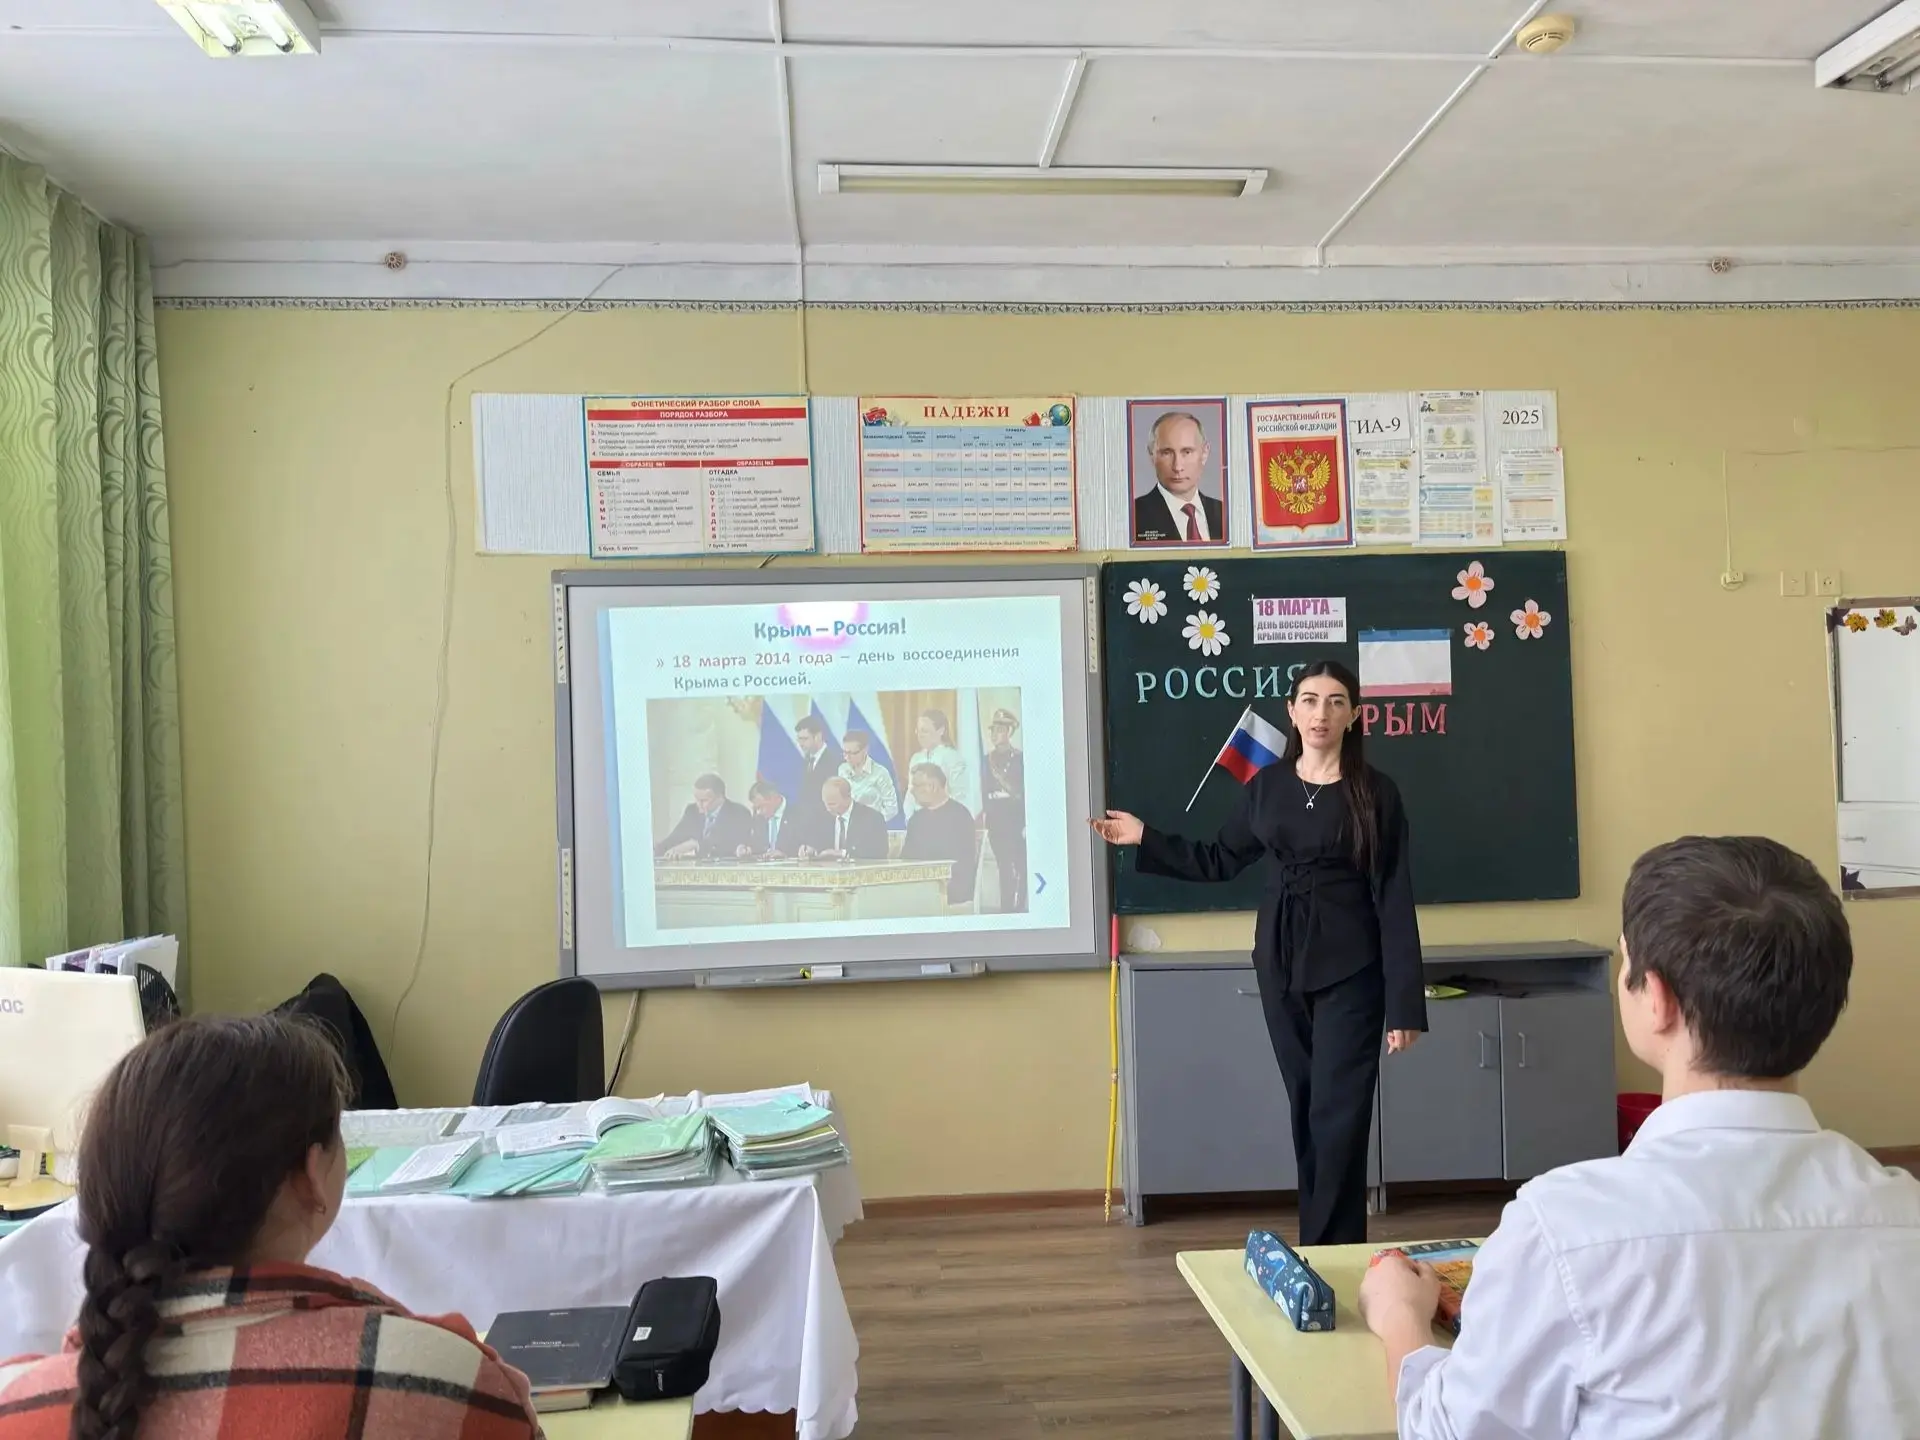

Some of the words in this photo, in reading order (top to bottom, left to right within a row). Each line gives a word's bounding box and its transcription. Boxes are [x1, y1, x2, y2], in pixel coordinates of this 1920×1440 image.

[631, 400, 696, 408] ФОНЕТИЧЕСКИЙ
[699, 400, 731, 408] РАЗБОР
[732, 399, 761, 407] СЛОВА
[660, 411, 694, 419] ПОРЯДОК
[695, 410, 729, 418] РАЗБОРА
[923, 405, 1010, 420] ПАДЕЖИ
[1257, 411, 1320, 422] ГОСУДАРСТВЕННЫЙ
[1321, 411, 1337, 420] ГЕРБ
[1502, 409, 1540, 425] 2025
[1257, 422, 1299, 432] РОССИЙСКОЙ
[1299, 422, 1337, 432] ФЕДЕРАЦИИ
[1256, 600, 1274, 616] 18
[1278, 599, 1330, 616] МАРТА
[754, 621, 812, 642] Крым
[833, 617, 907, 636] Россия!
[1257, 620, 1278, 631] ДЕНЬ
[1279, 619, 1344, 630] ВОССОЕДИНЕНИЯ
[1257, 632, 1287, 641] КРЫМА
[1287, 632, 1293, 640] С
[673, 655, 692, 668] 18
[699, 654, 747, 670] марта
[755, 652, 791, 666] 2014
[799, 652, 833, 666] года
[857, 651, 895, 665] день
[903, 647, 1020, 662] воссоединения
[674, 676, 729, 691] Крыма
[732, 678, 741, 688] с
[744, 672, 812, 688] Россией.
[1361, 702, 1447, 736] РЫМ
